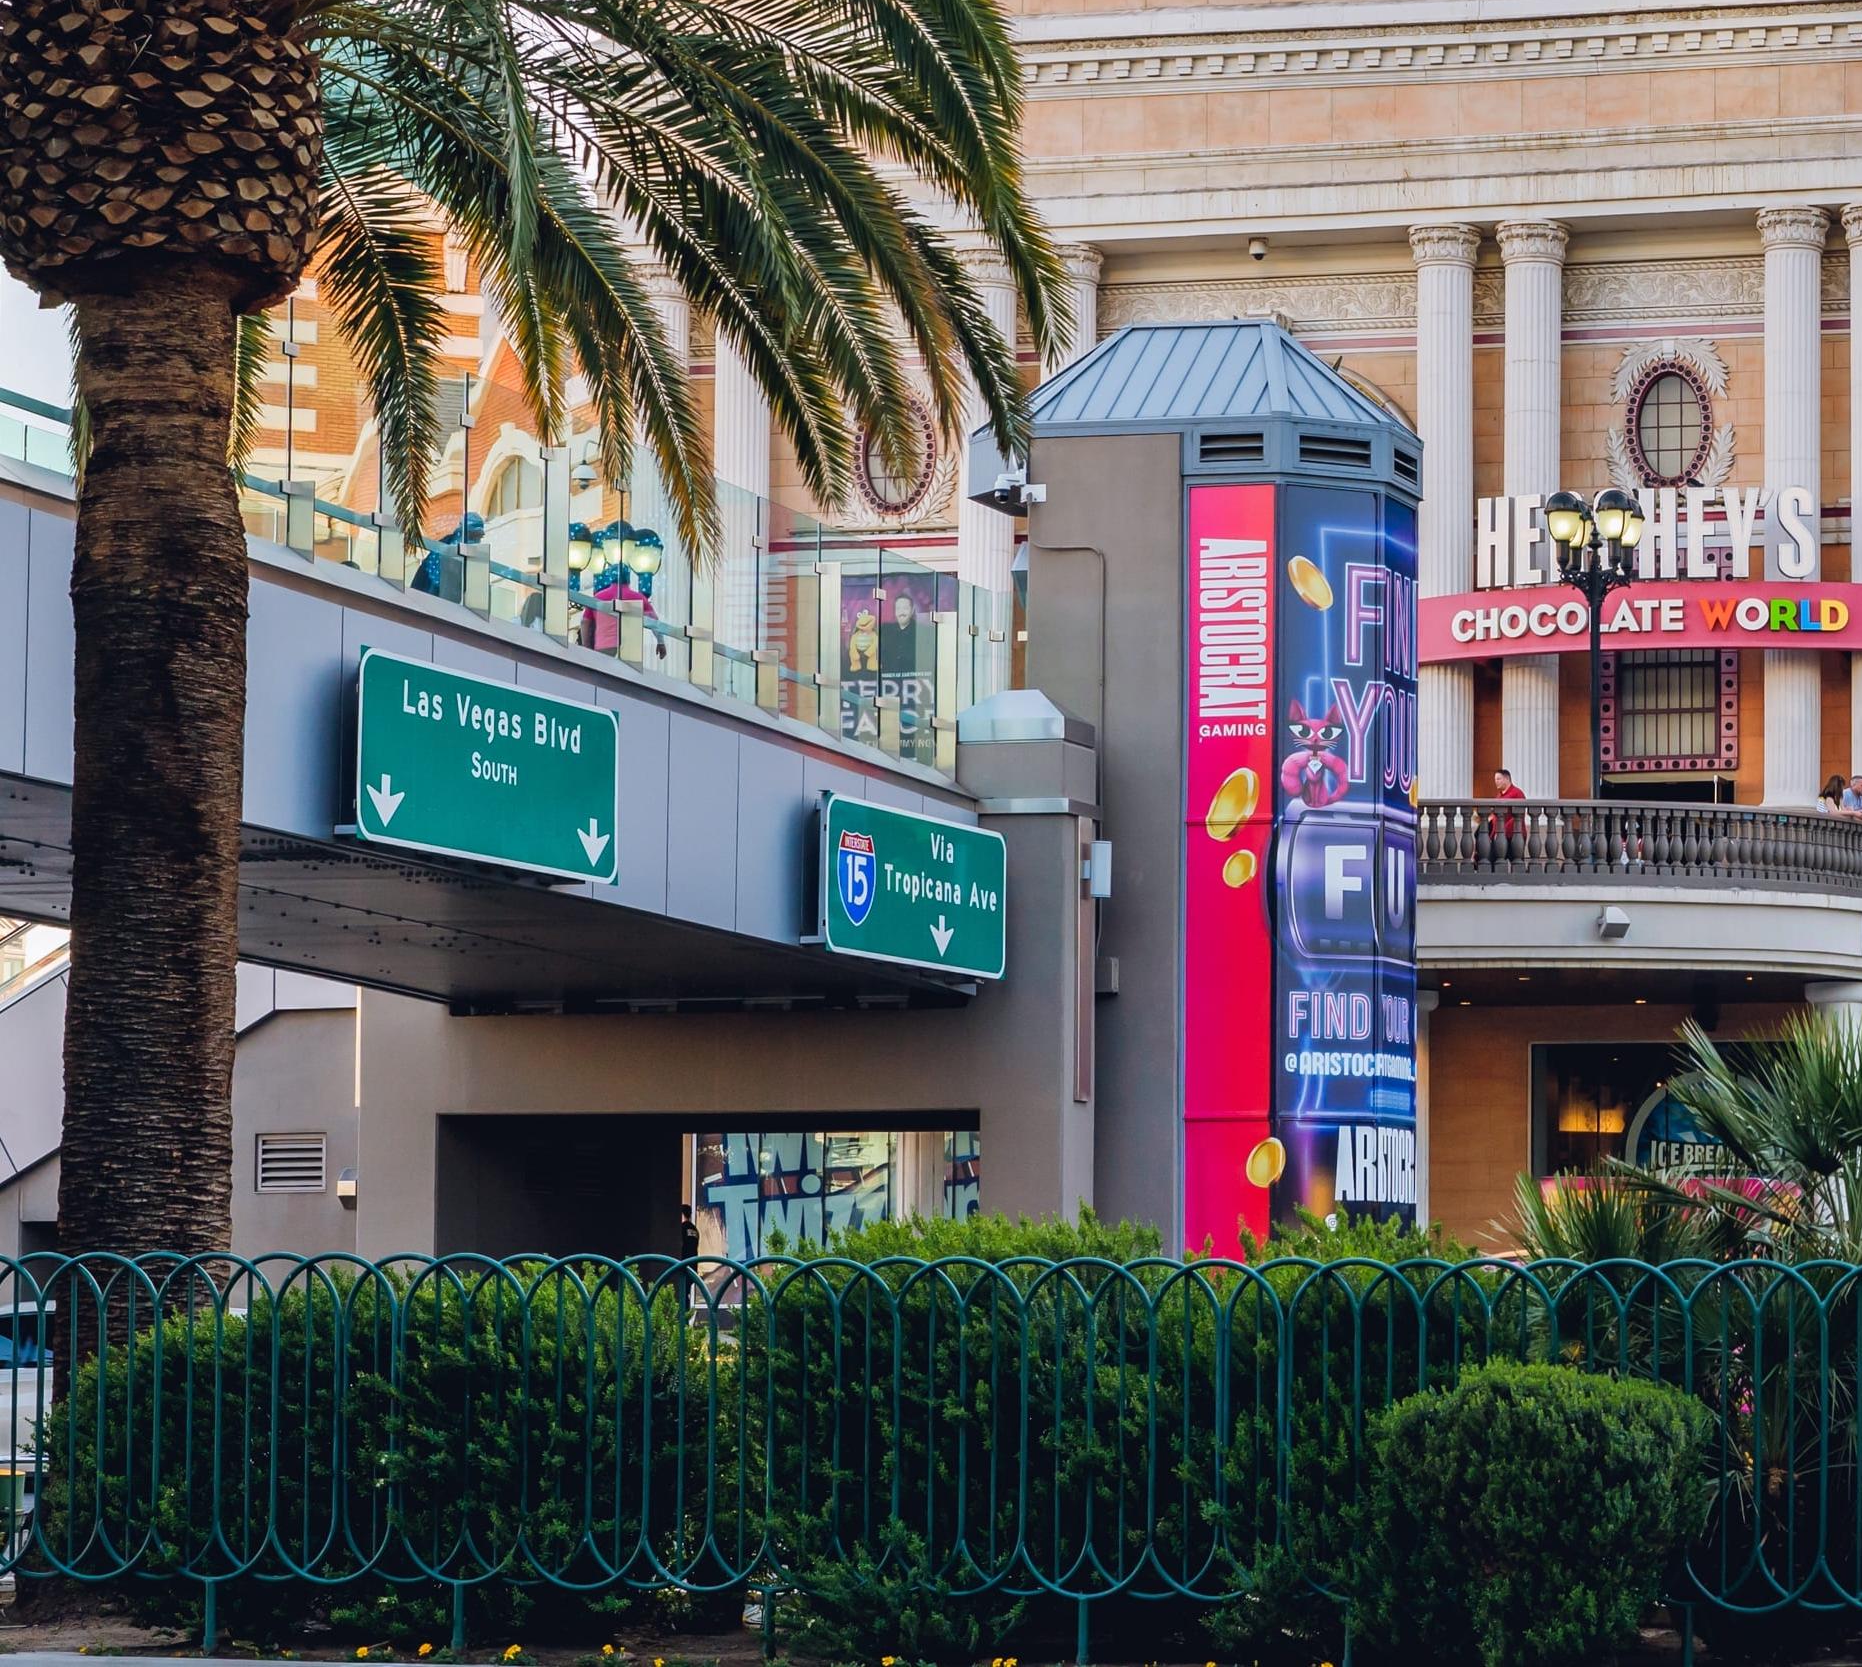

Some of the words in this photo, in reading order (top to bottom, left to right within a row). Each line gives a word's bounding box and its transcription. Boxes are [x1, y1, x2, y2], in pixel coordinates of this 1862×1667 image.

[1477, 486, 1816, 589] HEHEY'S
[1200, 538, 1267, 720] ARISTOCRAT
[1344, 562, 1418, 682] FIN
[1700, 598, 1849, 632] WORLD
[403, 679, 443, 720] Las
[456, 693, 521, 743] Vegas
[534, 712, 581, 754] Blvd
[1200, 724, 1266, 737] GAMING
[471, 751, 517, 786] SOUTH
[931, 833, 954, 863] Via
[846, 854, 868, 905] 15
[885, 863, 961, 903] Tropicana
[970, 882, 997, 911] Ave
[1288, 991, 1371, 1040] FIND
[1381, 994, 1410, 1045] YOUR
[1652, 1140, 1680, 1169] ICE
